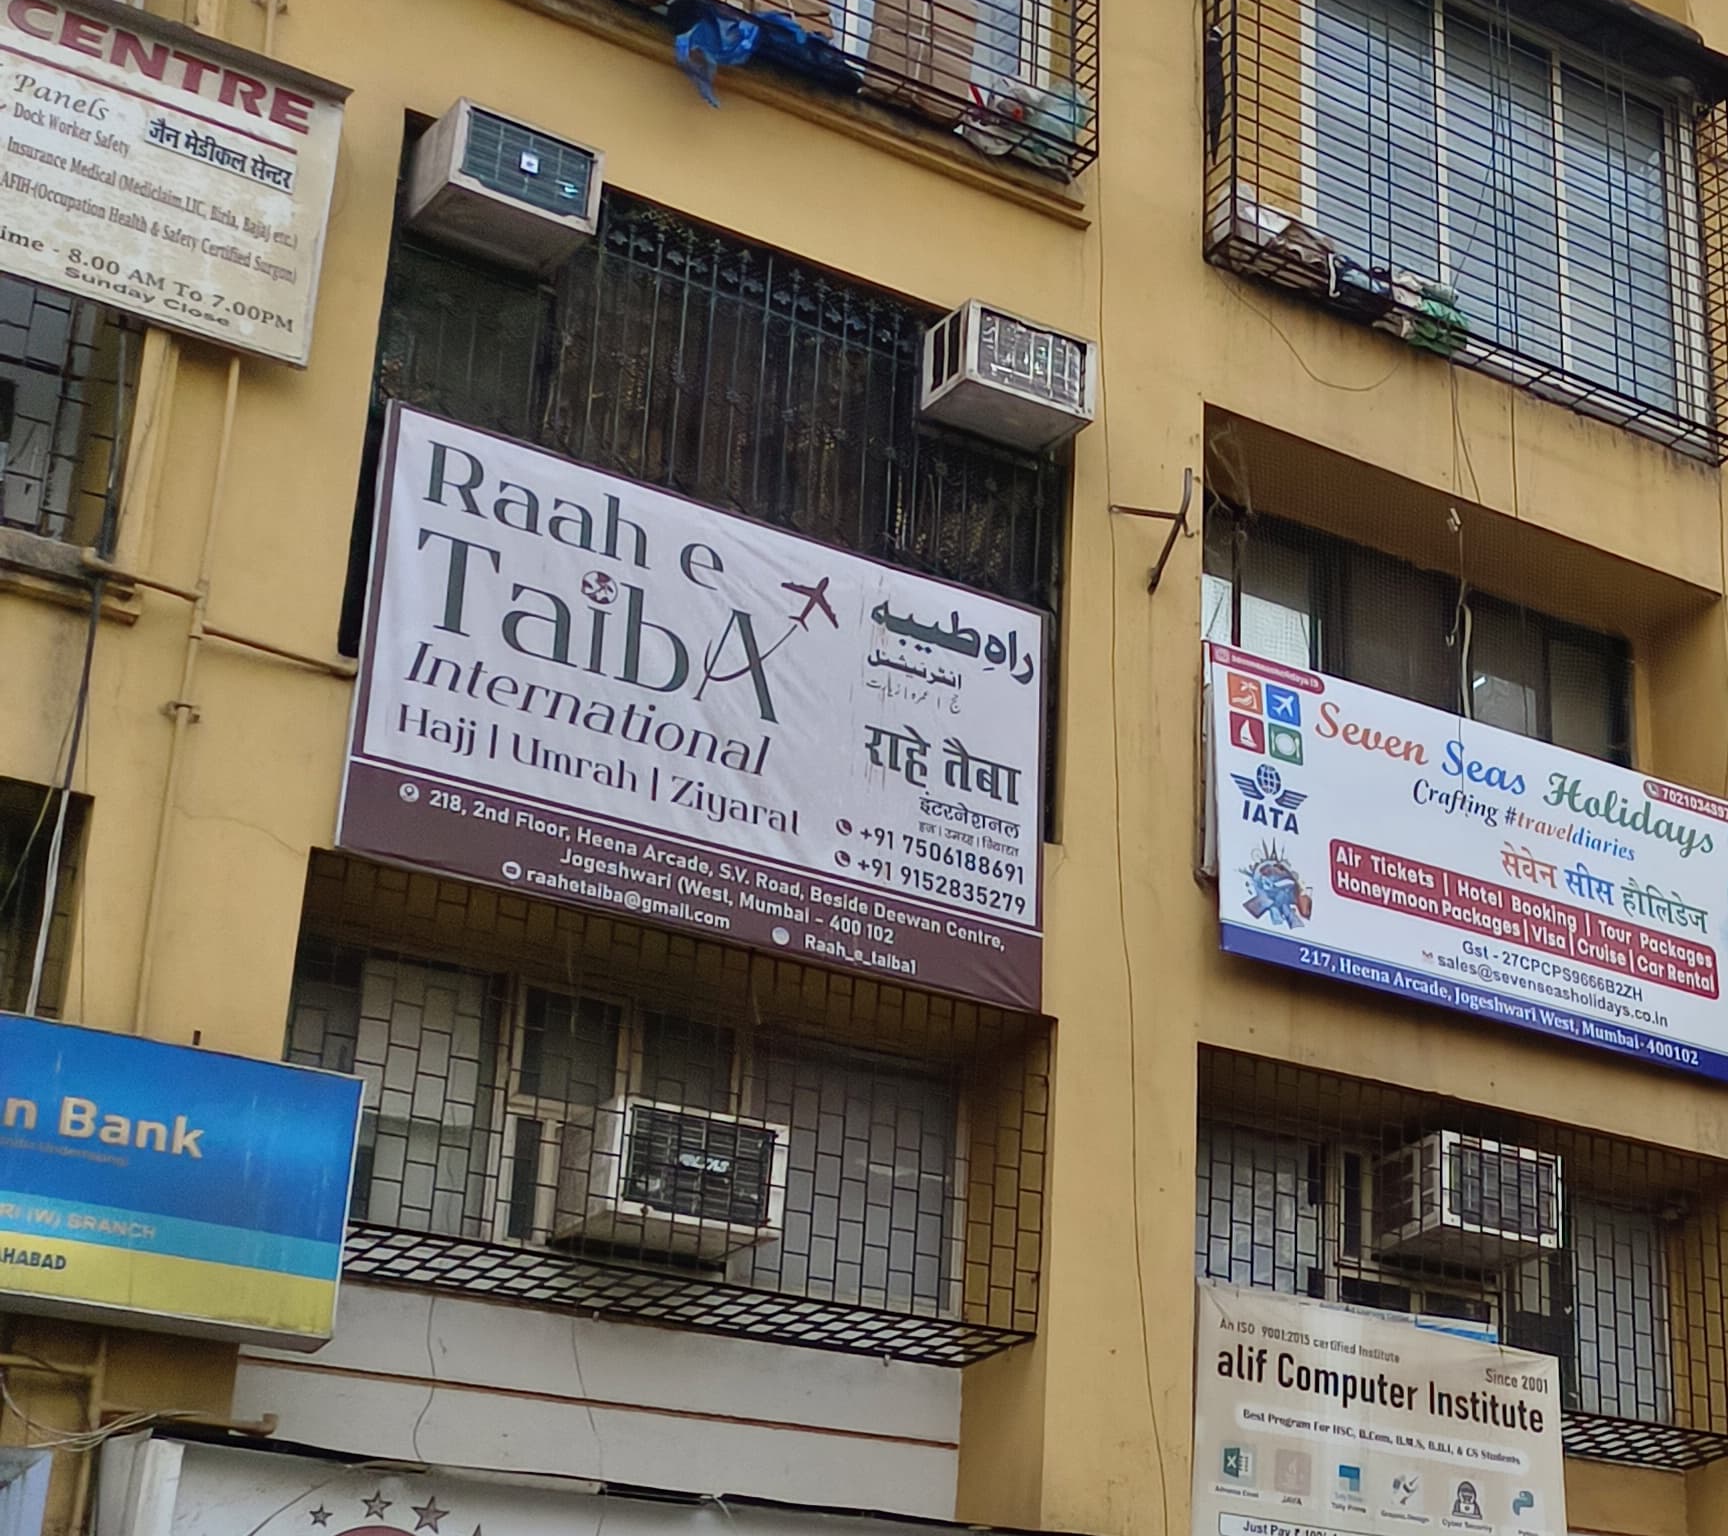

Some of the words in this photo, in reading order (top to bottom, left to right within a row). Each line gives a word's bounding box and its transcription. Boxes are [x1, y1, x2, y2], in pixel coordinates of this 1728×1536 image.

[12, 72, 110, 121] Panels
[14, 101, 45, 126] Dock
[49, 116, 92, 143] Worker
[7, 135, 67, 170] Insurance
[149, 117, 180, 150] जैन
[64, 266, 156, 305] Sunday
[163, 297, 230, 328] Close
[68, 248, 120, 276] 8.00
[127, 268, 165, 291] AM
[206, 293, 293, 333] 7.00PM
[422, 439, 652, 570] Raah
[404, 641, 772, 776] International
[398, 703, 479, 757] Hajj
[512, 733, 638, 793] Umrah
[670, 775, 800, 836] Ziyarat
[864, 725, 931, 789] राहे
[942, 736, 1022, 806] तैबा
[1314, 701, 1429, 766] Seven
[1442, 739, 1526, 796] Seas
[1543, 772, 1714, 858] Holidays
[1242, 799, 1300, 836] IATA
[1413, 778, 1499, 828] Crafting
[473, 801, 509, 825] 2nd
[515, 811, 571, 842] Floor,
[577, 826, 638, 857] Heena
[642, 843, 714, 879] Arcade,
[903, 833, 1024, 885] 7506188691
[560, 847, 672, 890] Jogeshwari
[900, 866, 1026, 917] 9152835279
[1500, 840, 1557, 889] सेवेन
[1563, 862, 1615, 907] सीस
[1621, 876, 1709, 934] हौलिडेज
[525, 866, 731, 932] raahetaiba@gmail.com
[1336, 846, 1362, 868] Air
[1371, 854, 1435, 888] Tickets
[1457, 880, 1504, 908] Hotel
[1511, 895, 1577, 933] Booking
[1598, 919, 1632, 945] Tour
[1639, 932, 1713, 968] Packages
[1337, 870, 1439, 914] Honeymoon
[1442, 900, 1521, 936] Packages
[1531, 924, 1566, 950] Visa
[1577, 938, 1627, 967] Cruise
[1637, 955, 1664, 978] Car
[1667, 967, 1715, 993] Rental
[1299, 947, 1336, 972] 217,
[1340, 956, 1390, 984] Heena
[1393, 971, 1452, 1002] Arcade,
[59, 1096, 205, 1160] Bank
[68, 1213, 156, 1239] BRANCH
[0, 1247, 66, 1270] HABAD
[1237, 1321, 1255, 1336] ISO
[1217, 1343, 1268, 1383] alif
[1277, 1351, 1419, 1411] Computer
[1429, 1380, 1544, 1434] Institute
[1485, 1368, 1518, 1388] Since
[1521, 1375, 1549, 1394] 2001
[1243, 1519, 1268, 1535] Just
